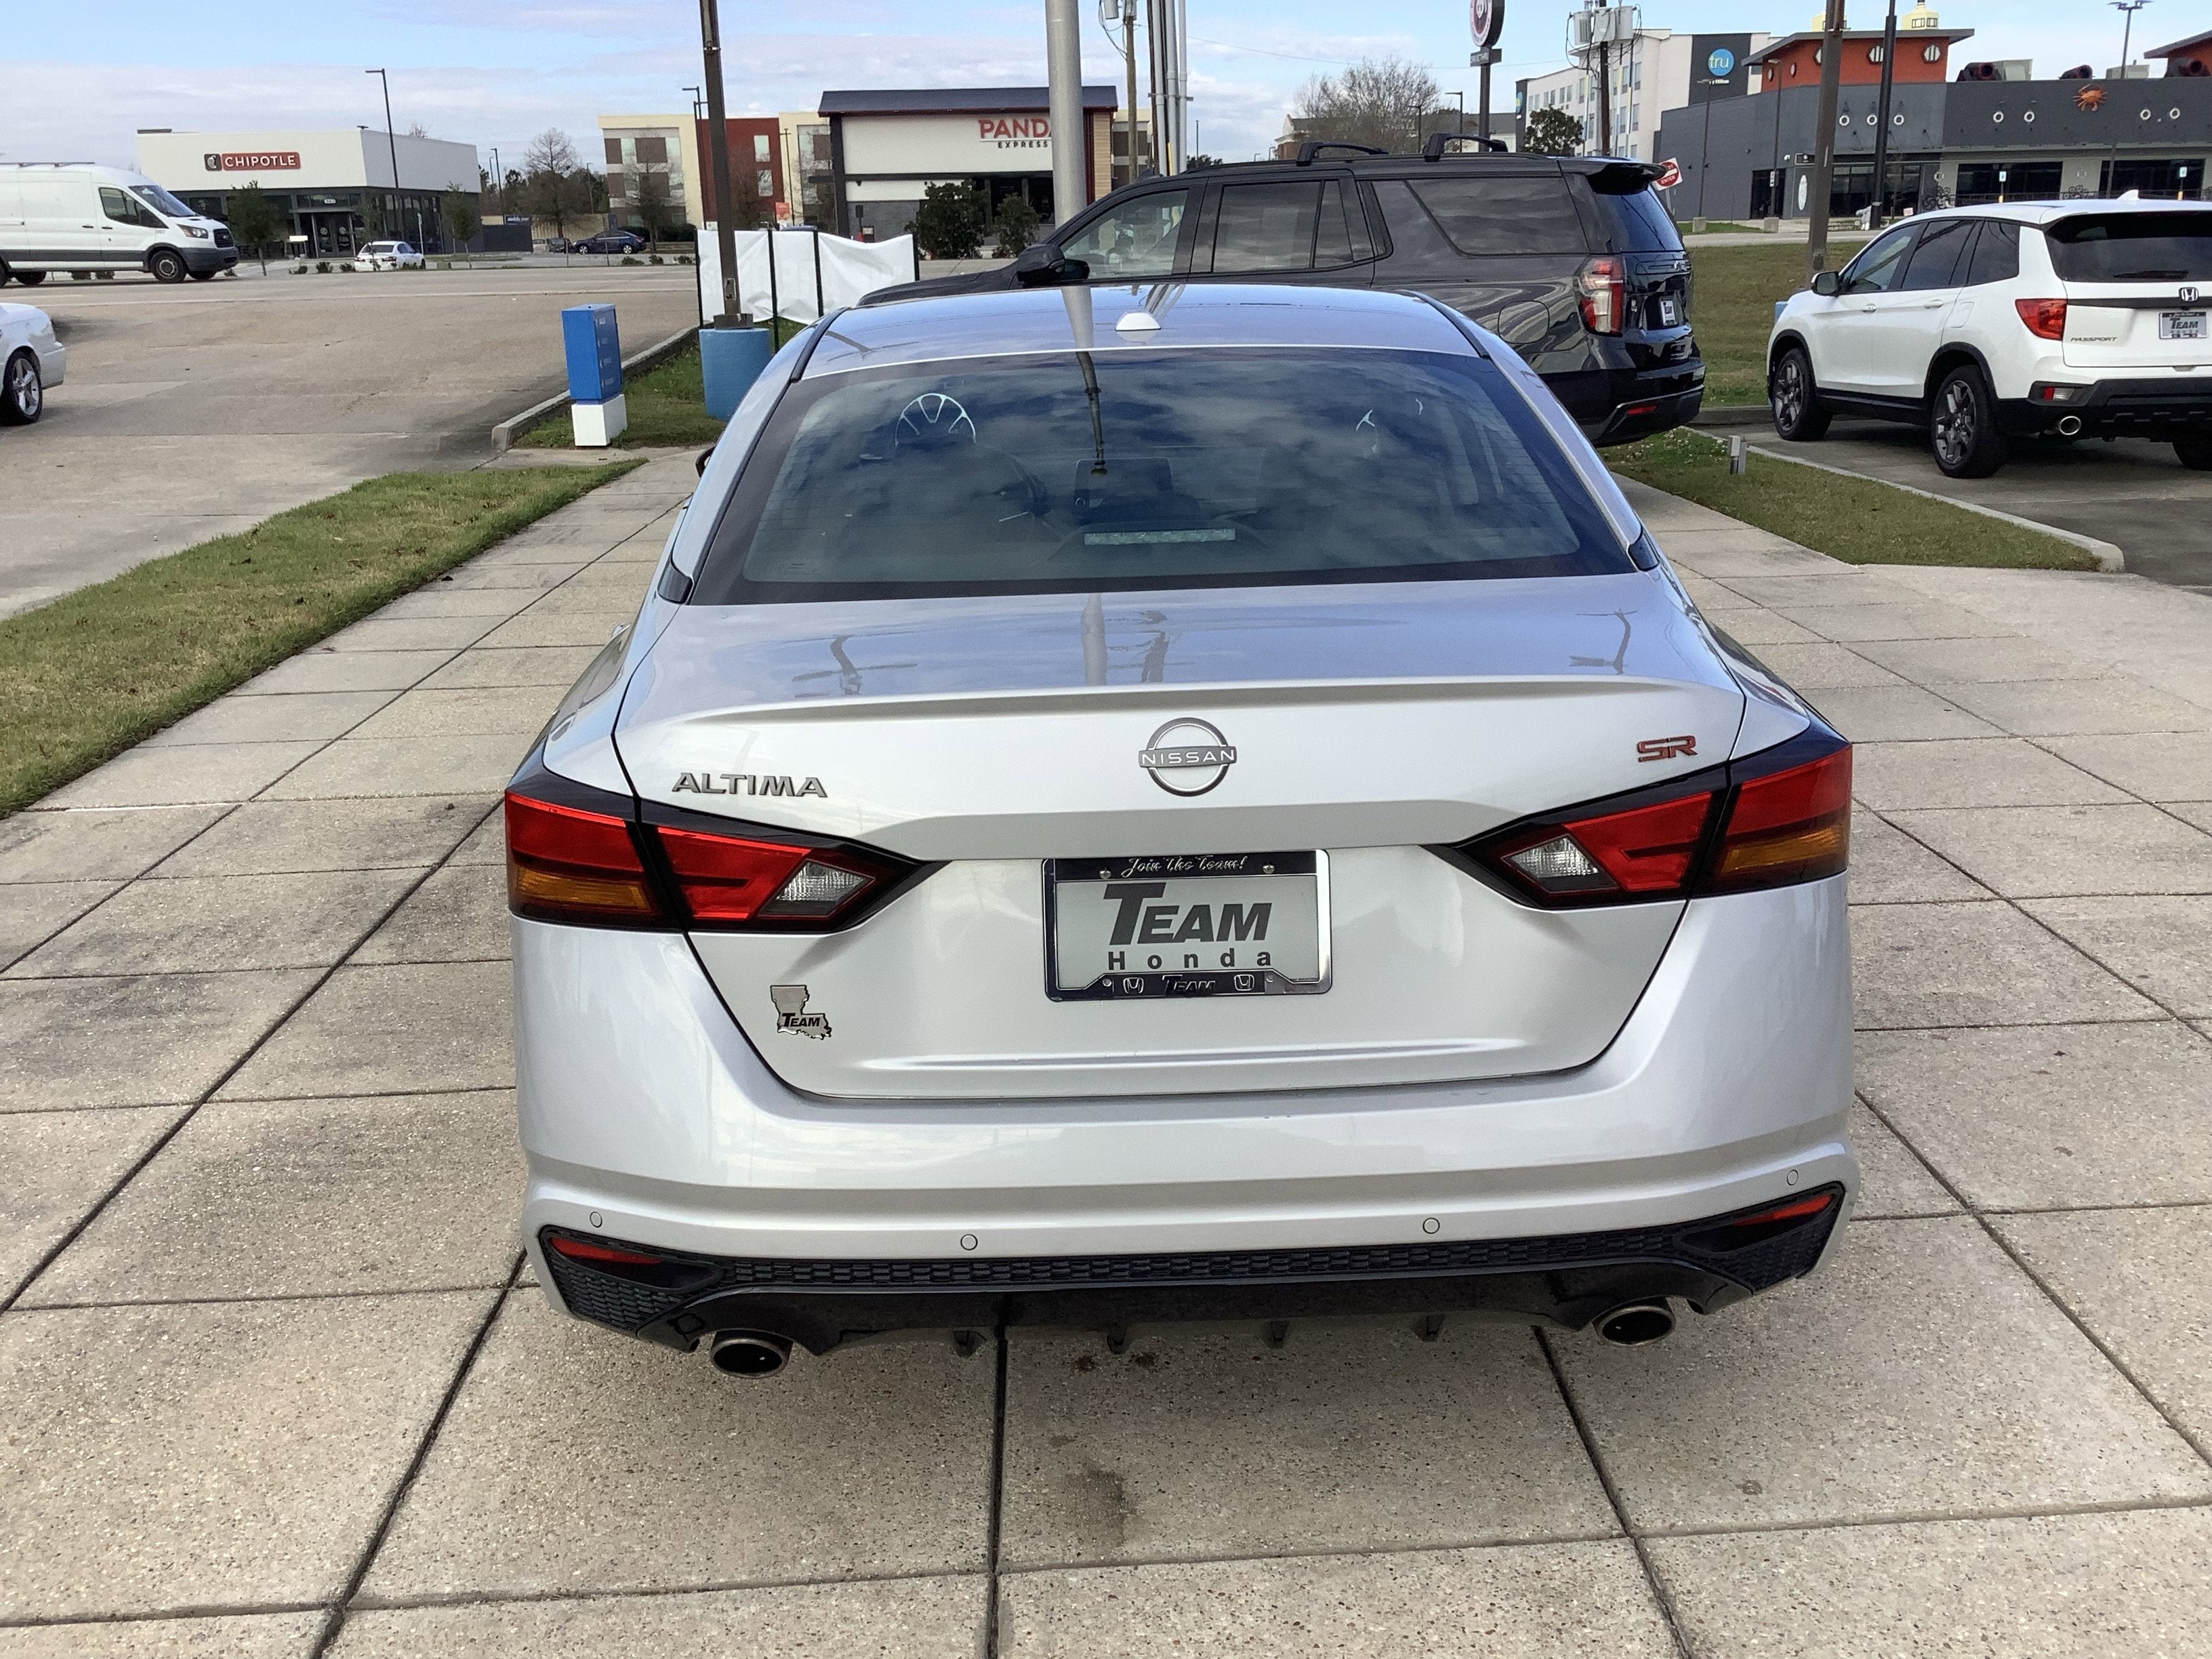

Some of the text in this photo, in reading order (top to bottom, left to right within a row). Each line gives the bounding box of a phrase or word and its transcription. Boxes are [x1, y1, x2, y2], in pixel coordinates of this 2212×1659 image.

[1709, 55, 1729, 68] tru
[978, 118, 1052, 139] PAND
[224, 155, 296, 167] CHIPOTLE
[1661, 175, 1676, 184] ENTER
[2170, 318, 2198, 329] TEAM
[1141, 749, 1235, 765] NISSAN
[1637, 735, 1698, 762] SR
[672, 773, 828, 798] ALTIMA
[1121, 858, 1162, 878] Join
[1195, 855, 1248, 870] Team!
[1103, 882, 1272, 945] TEAM
[1108, 948, 1271, 970] Honda
[1162, 974, 1216, 994] TEAM
[782, 1012, 820, 1027] TEAM
